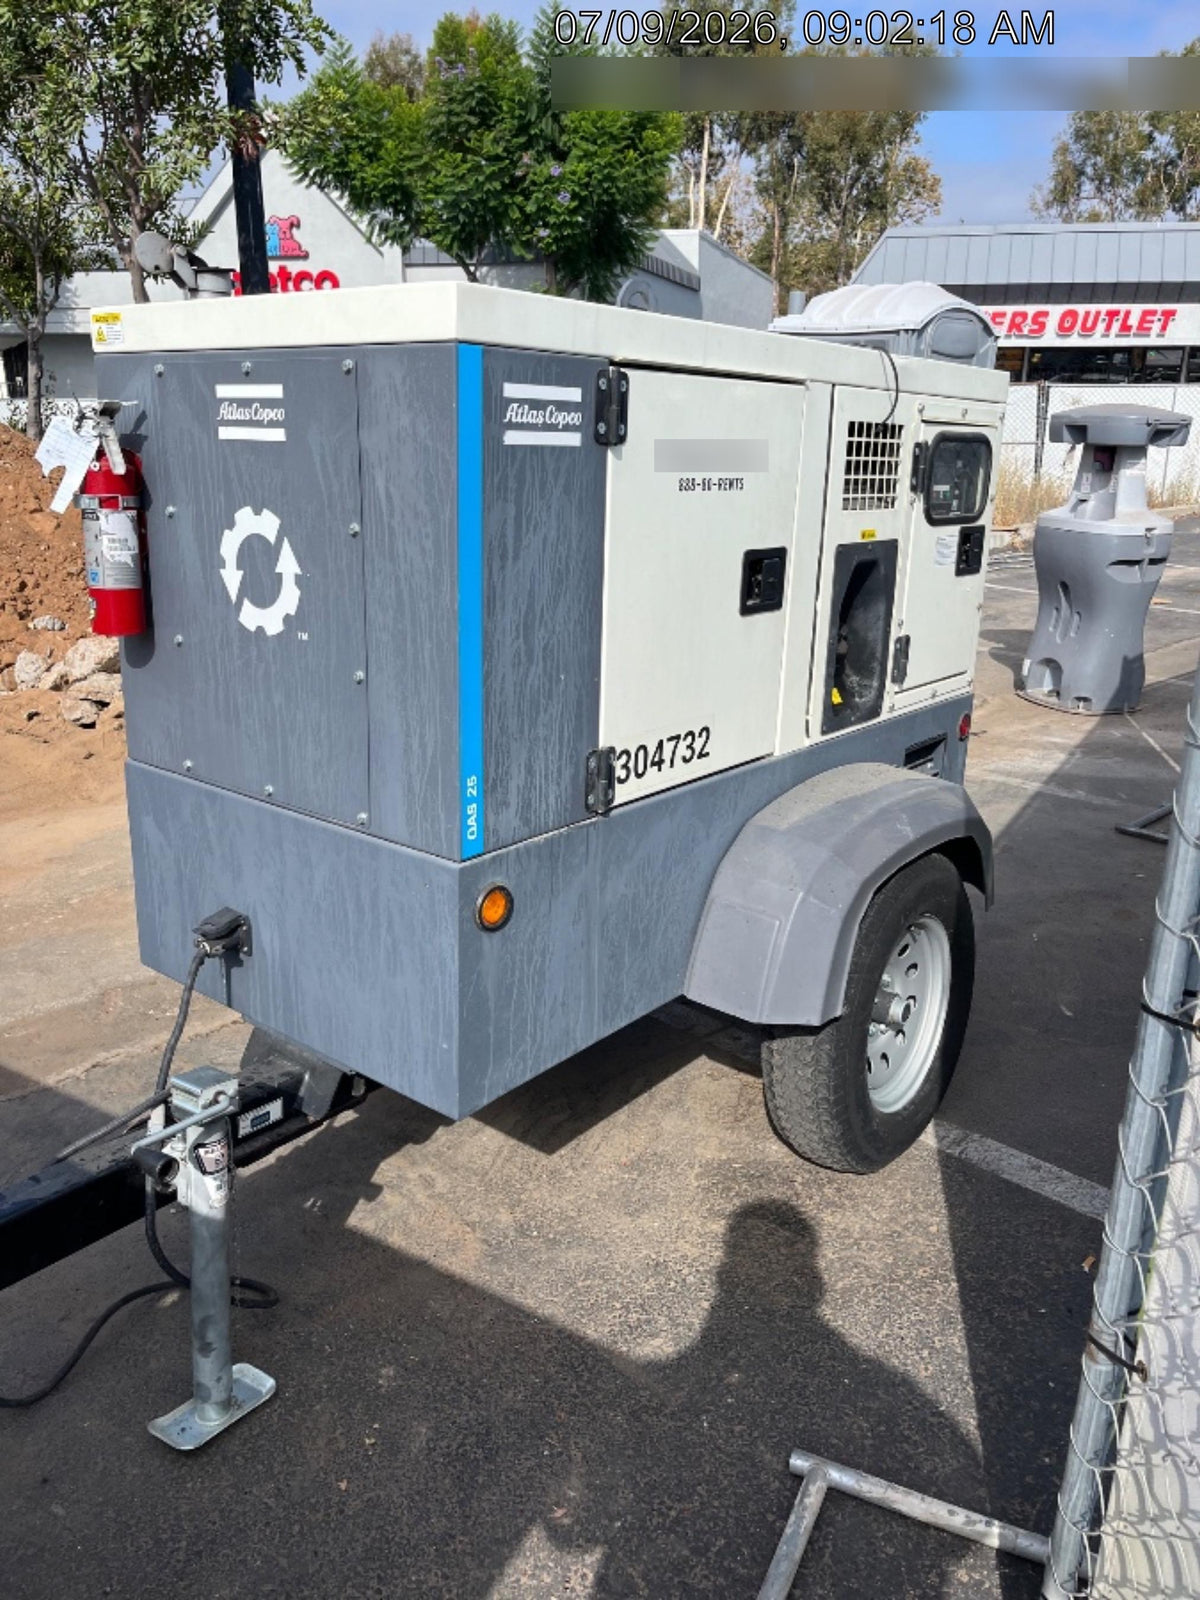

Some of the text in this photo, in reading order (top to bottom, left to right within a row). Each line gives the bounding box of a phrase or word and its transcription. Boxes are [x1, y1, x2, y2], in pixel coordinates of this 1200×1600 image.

[232, 265, 340, 296] tco
[984, 308, 1178, 337] ERS OUTLET
[216, 401, 286, 425] Atlas Copco
[503, 402, 582, 429] Atlas Copco
[616, 725, 711, 785] 304732
[466, 774, 478, 798] 25
